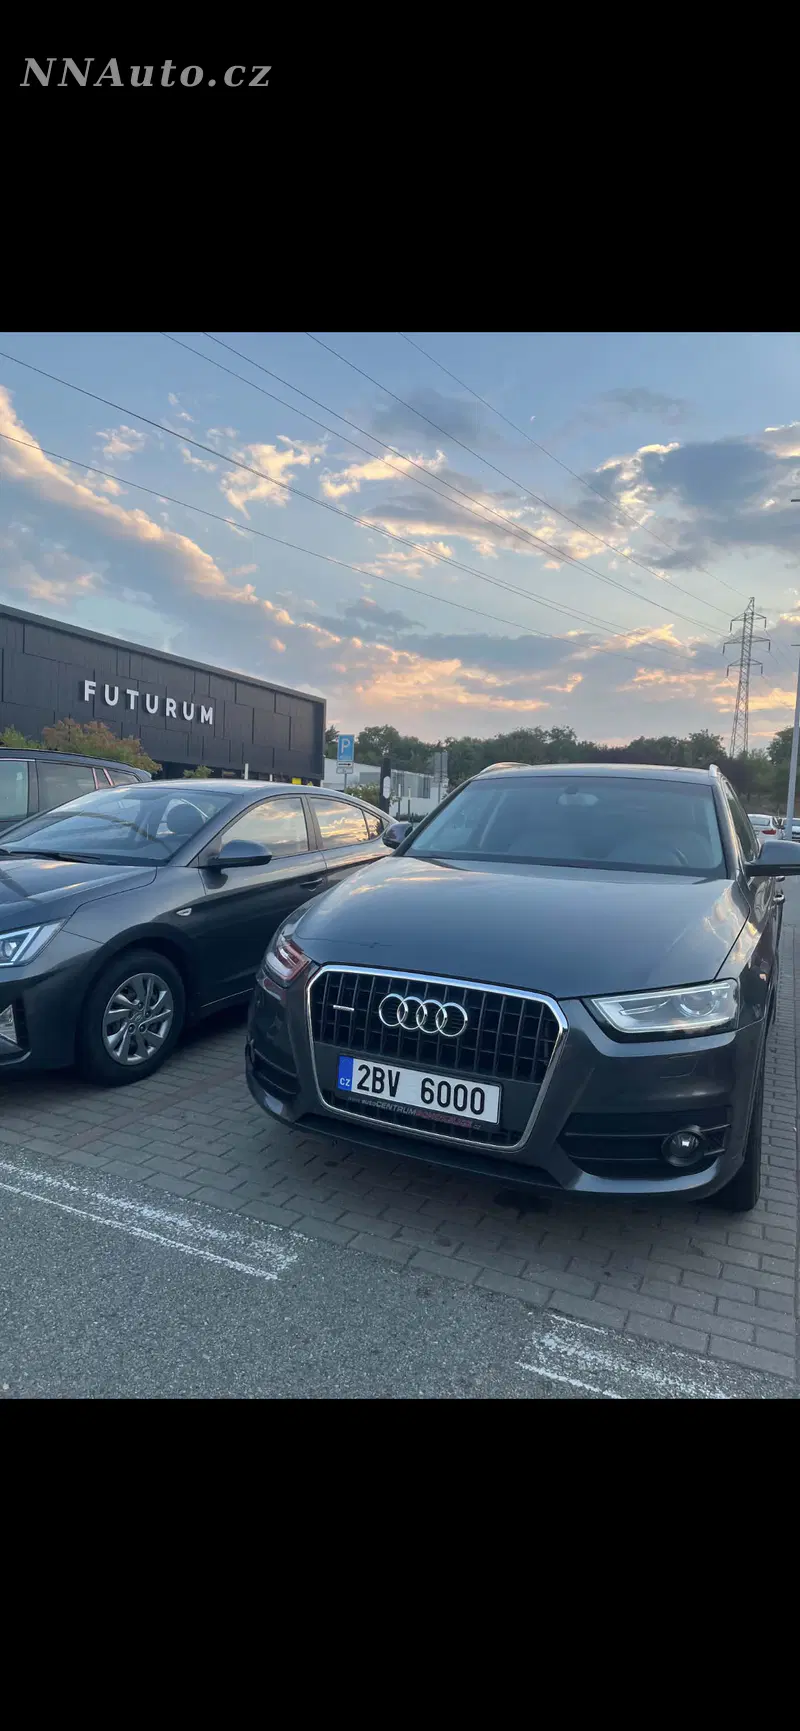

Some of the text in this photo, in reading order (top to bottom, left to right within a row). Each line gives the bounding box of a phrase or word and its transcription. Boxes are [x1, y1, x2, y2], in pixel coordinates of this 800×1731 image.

[84, 679, 213, 725] FUTURUM
[341, 738, 350, 754] P
[339, 1077, 351, 1087] CZ
[357, 1064, 485, 1115] 2BV 6000
